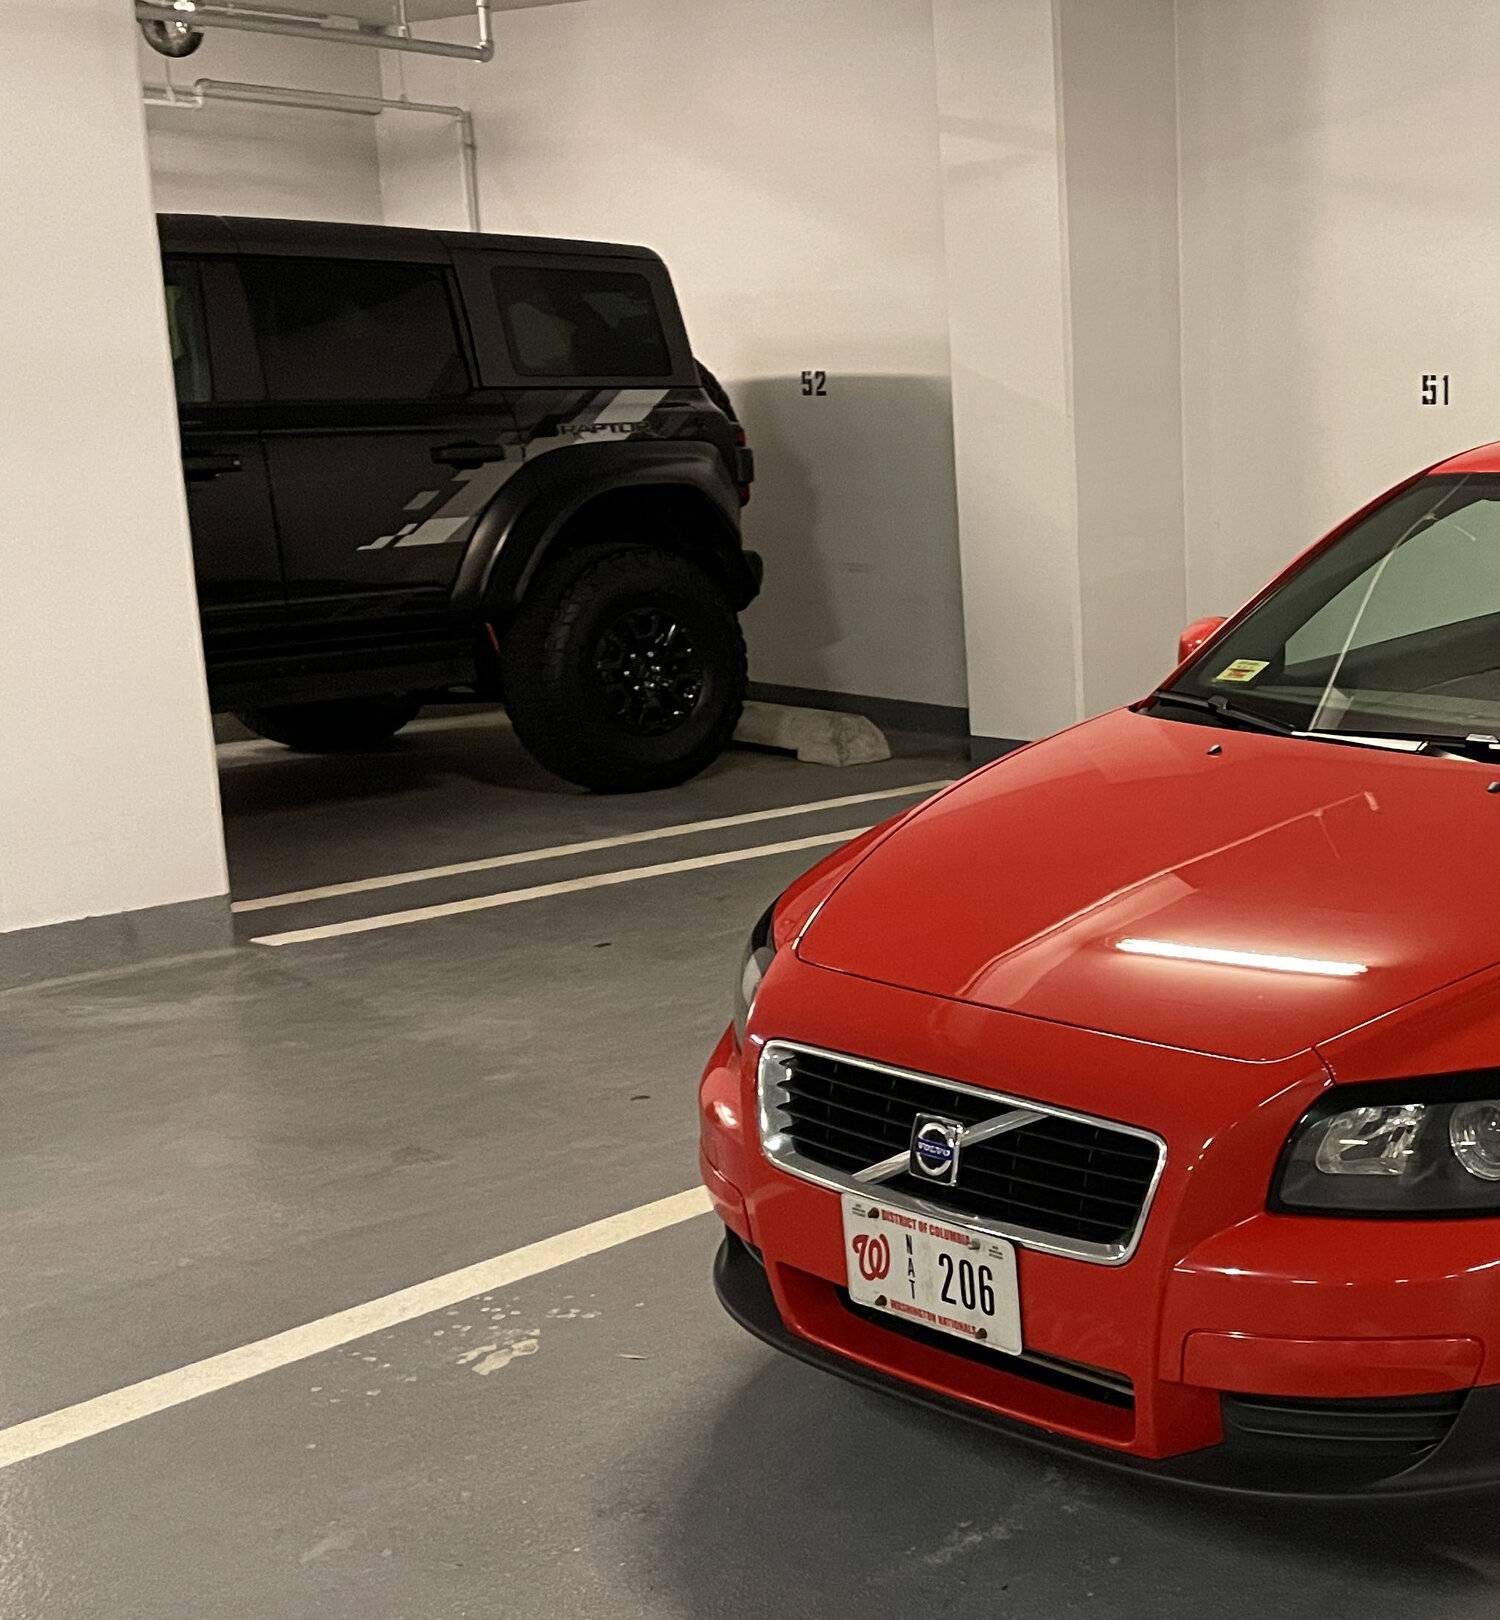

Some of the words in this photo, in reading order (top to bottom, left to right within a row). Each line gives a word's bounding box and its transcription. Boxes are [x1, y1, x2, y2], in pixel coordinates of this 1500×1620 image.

[801, 370, 827, 396] 52
[1422, 374, 1449, 406] 51
[561, 422, 651, 437] RAPTOR
[918, 1141, 951, 1157] VOLVO
[881, 1209, 917, 1230] DISTRICT
[918, 1221, 928, 1233] OF
[938, 1252, 996, 1316] 206
